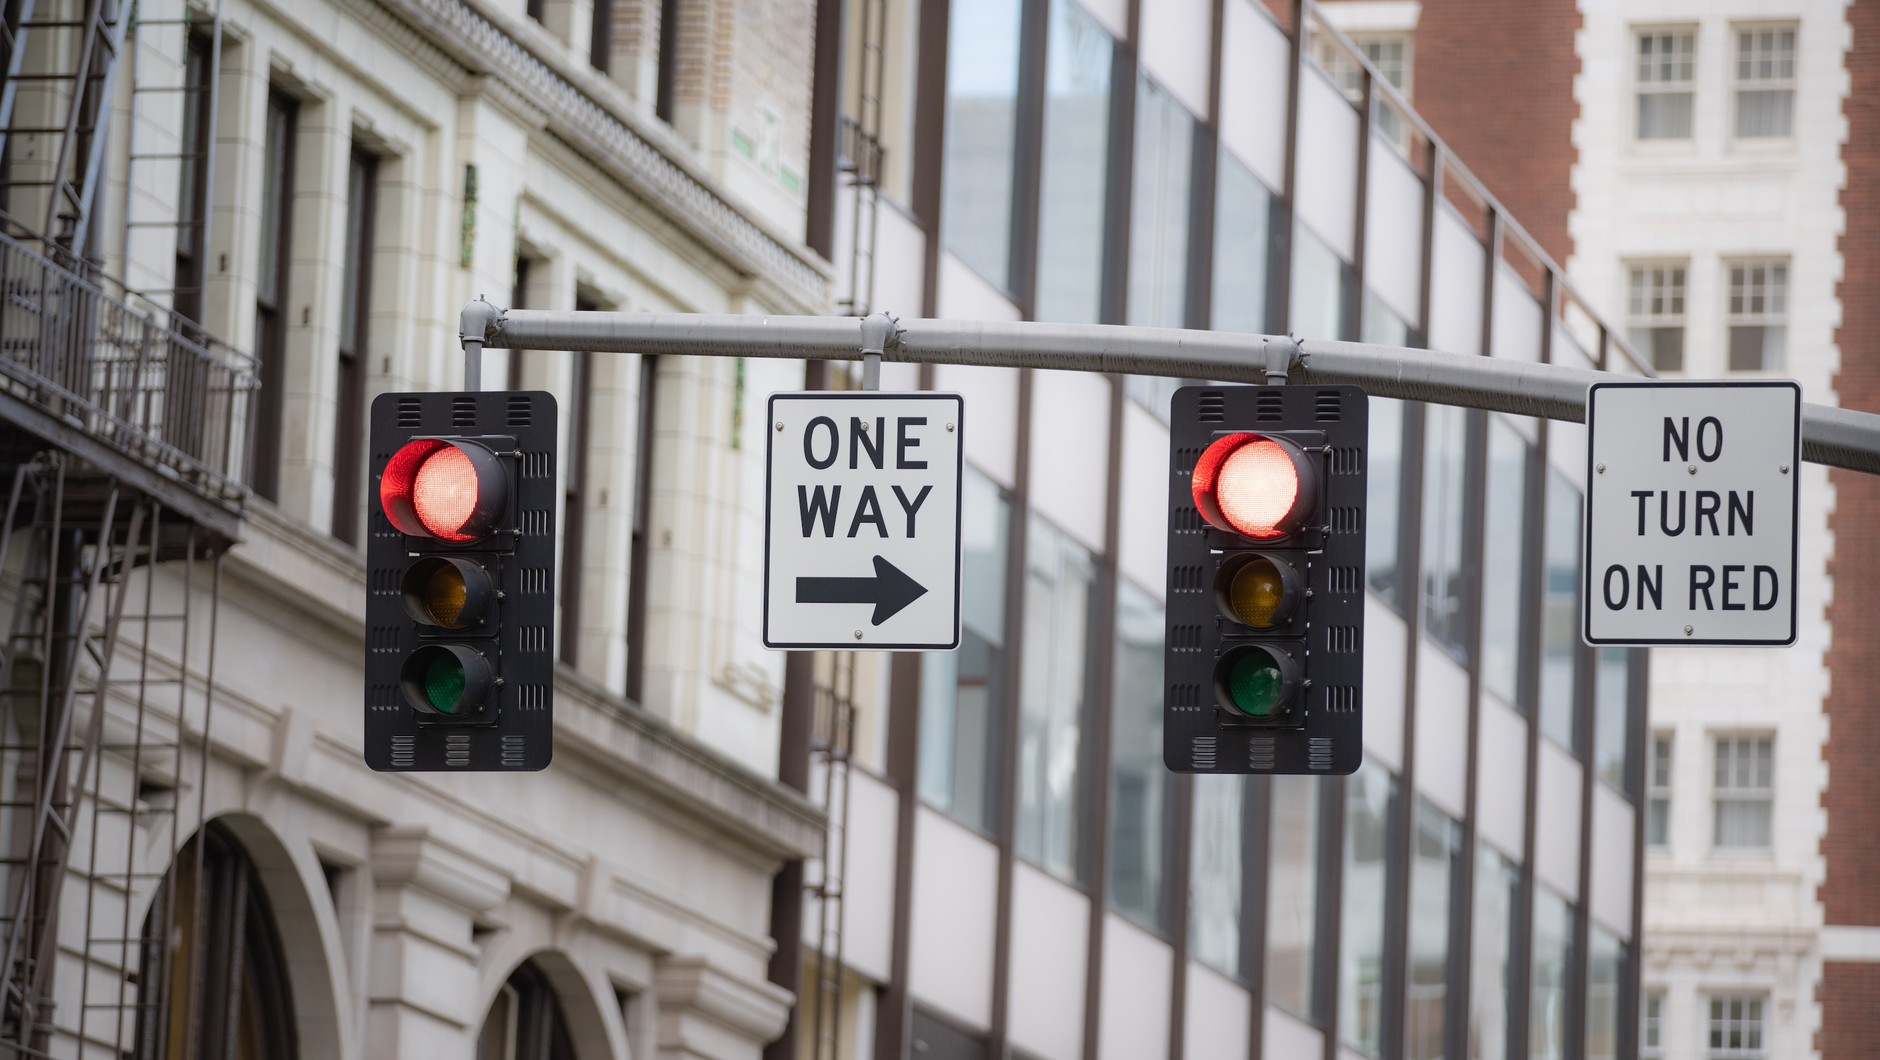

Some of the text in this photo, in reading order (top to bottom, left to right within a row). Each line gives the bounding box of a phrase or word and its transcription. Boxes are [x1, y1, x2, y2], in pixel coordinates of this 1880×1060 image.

[803, 415, 928, 470] ONE
[1662, 415, 1724, 463] NO
[797, 484, 934, 539] WAY
[1630, 490, 1754, 538] TURN
[1602, 563, 1779, 612] ON RED
